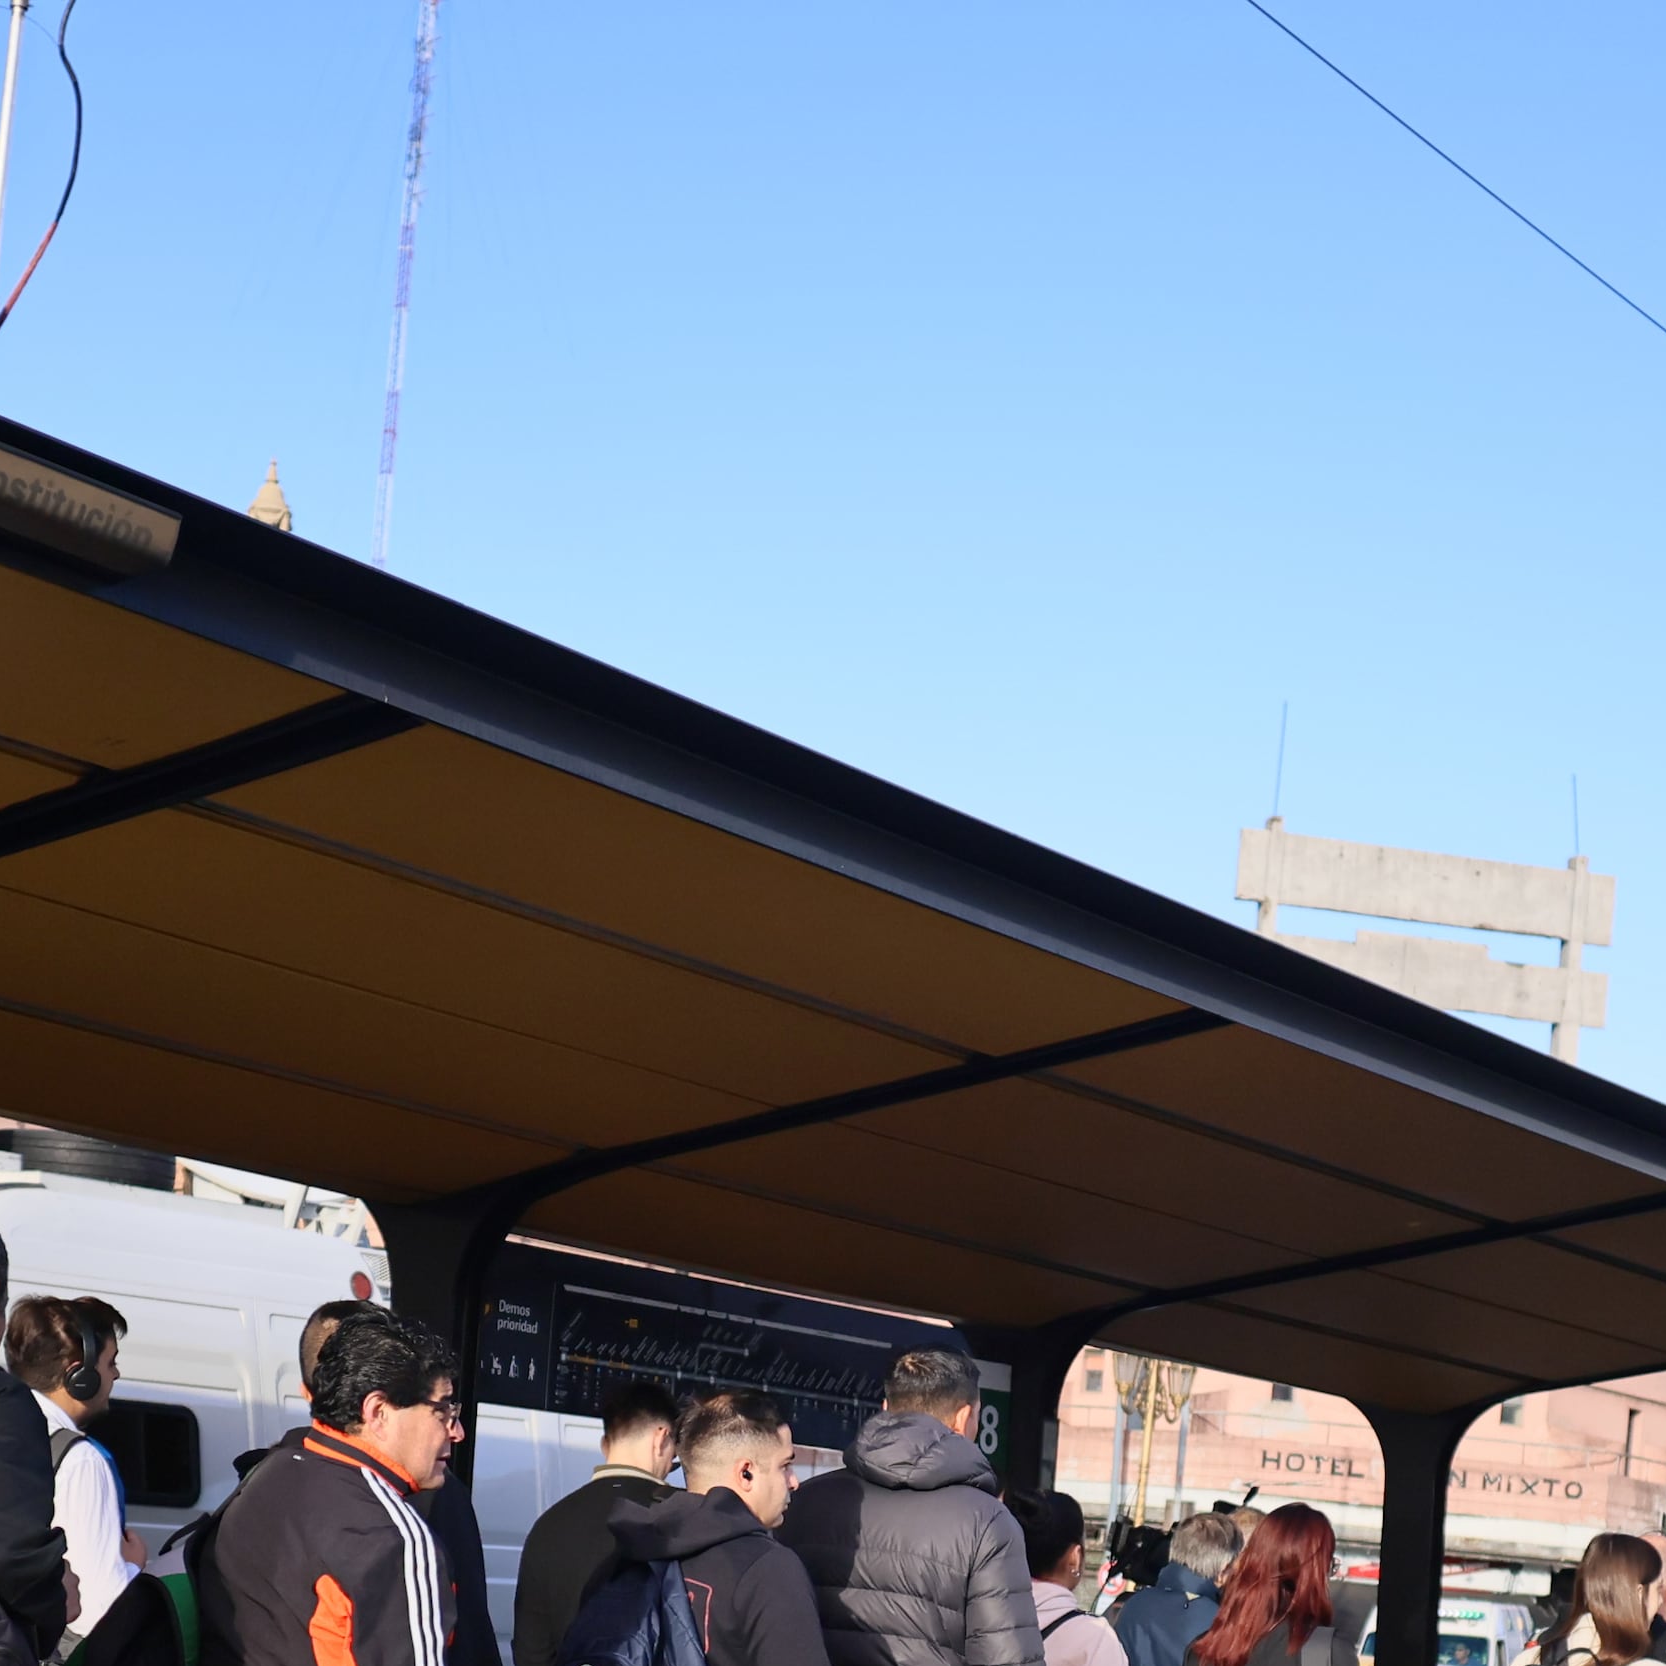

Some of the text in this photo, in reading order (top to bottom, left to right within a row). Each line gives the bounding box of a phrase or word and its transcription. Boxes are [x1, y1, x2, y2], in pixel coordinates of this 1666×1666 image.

[498, 1299, 531, 1317] Demos
[497, 1317, 539, 1334] prioridad
[1261, 1450, 1366, 1478] HOTEL
